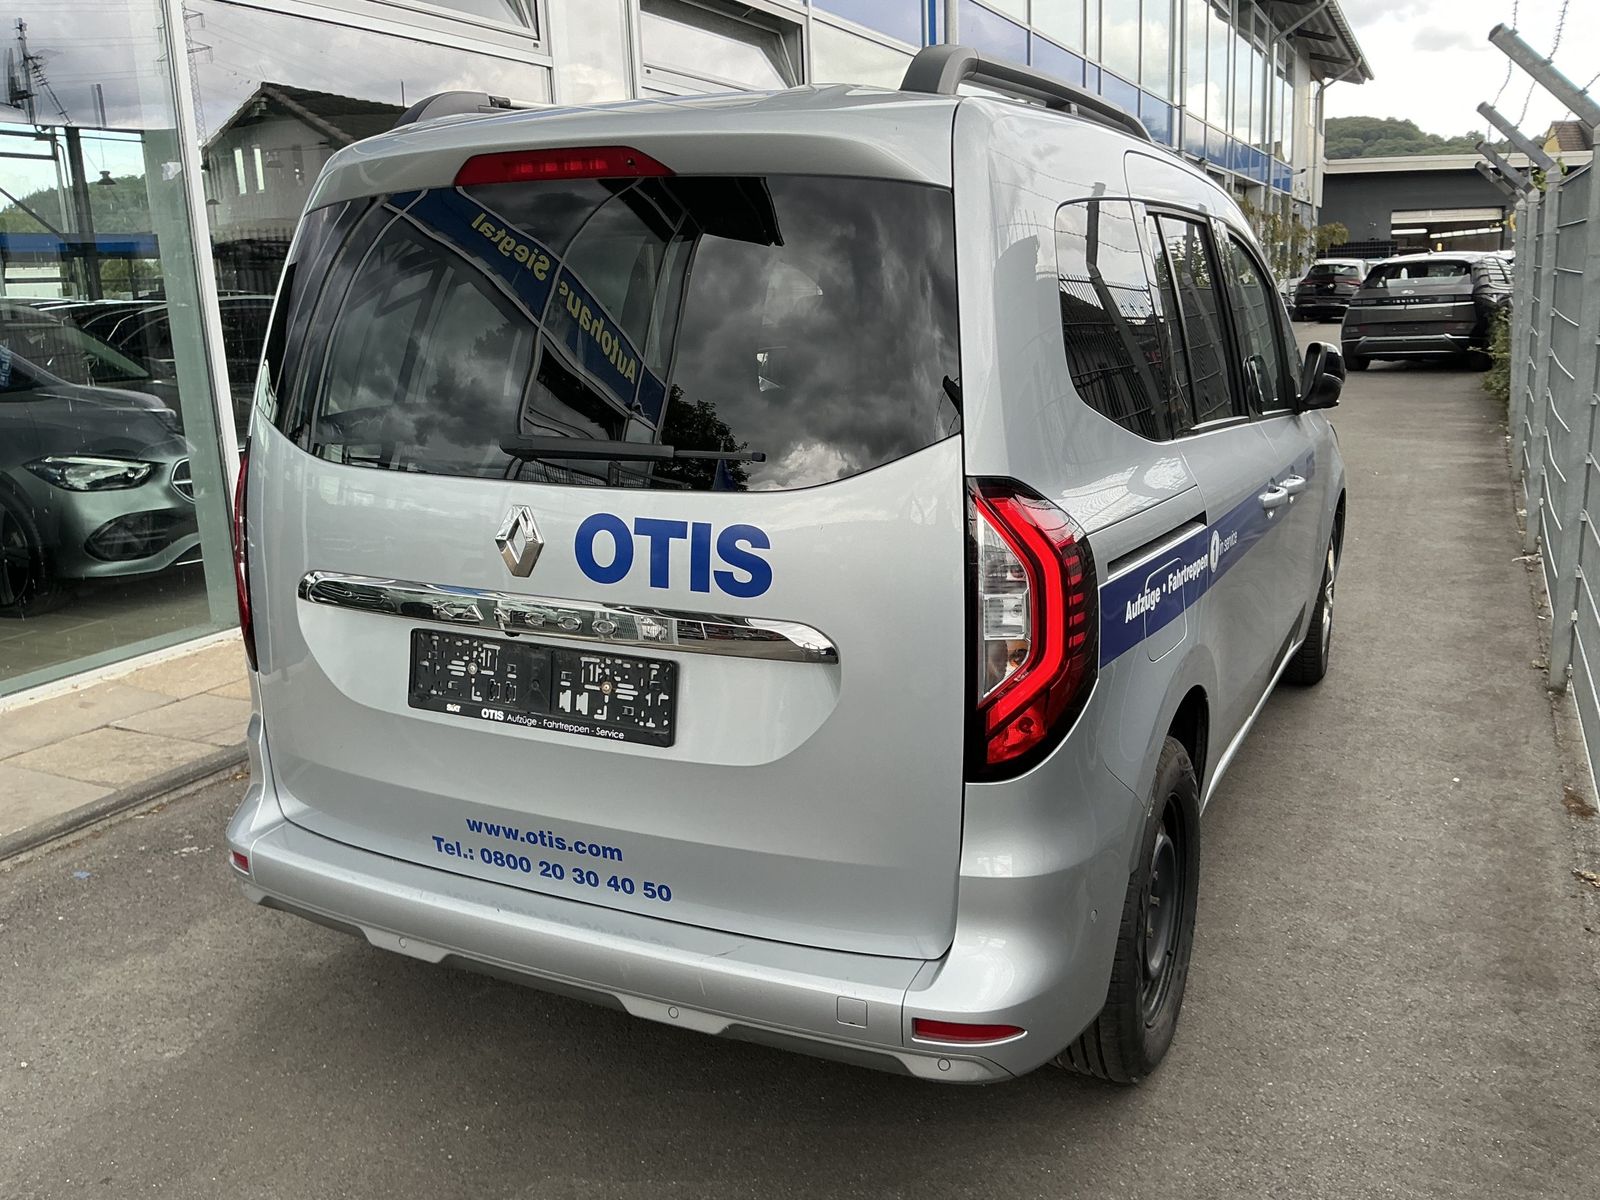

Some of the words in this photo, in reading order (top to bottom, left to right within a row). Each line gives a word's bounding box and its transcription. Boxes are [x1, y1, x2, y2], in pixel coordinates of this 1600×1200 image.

[574, 512, 773, 598] OTIS
[1124, 585, 1161, 624] Aufzüge
[1167, 553, 1208, 595] Fahrtreppen
[432, 600, 619, 636] KANGOO
[481, 708, 504, 720] OTIS
[507, 714, 538, 727] Aufzüge
[543, 719, 590, 733] Fahrtreppen
[596, 727, 625, 739] Service
[466, 818, 623, 861] www.otis.com
[432, 835, 474, 860] Tel.:
[480, 848, 531, 873] 0800
[538, 861, 565, 880] 20
[572, 868, 599, 888] 30
[607, 875, 635, 895] 40
[643, 882, 672, 902] 50
